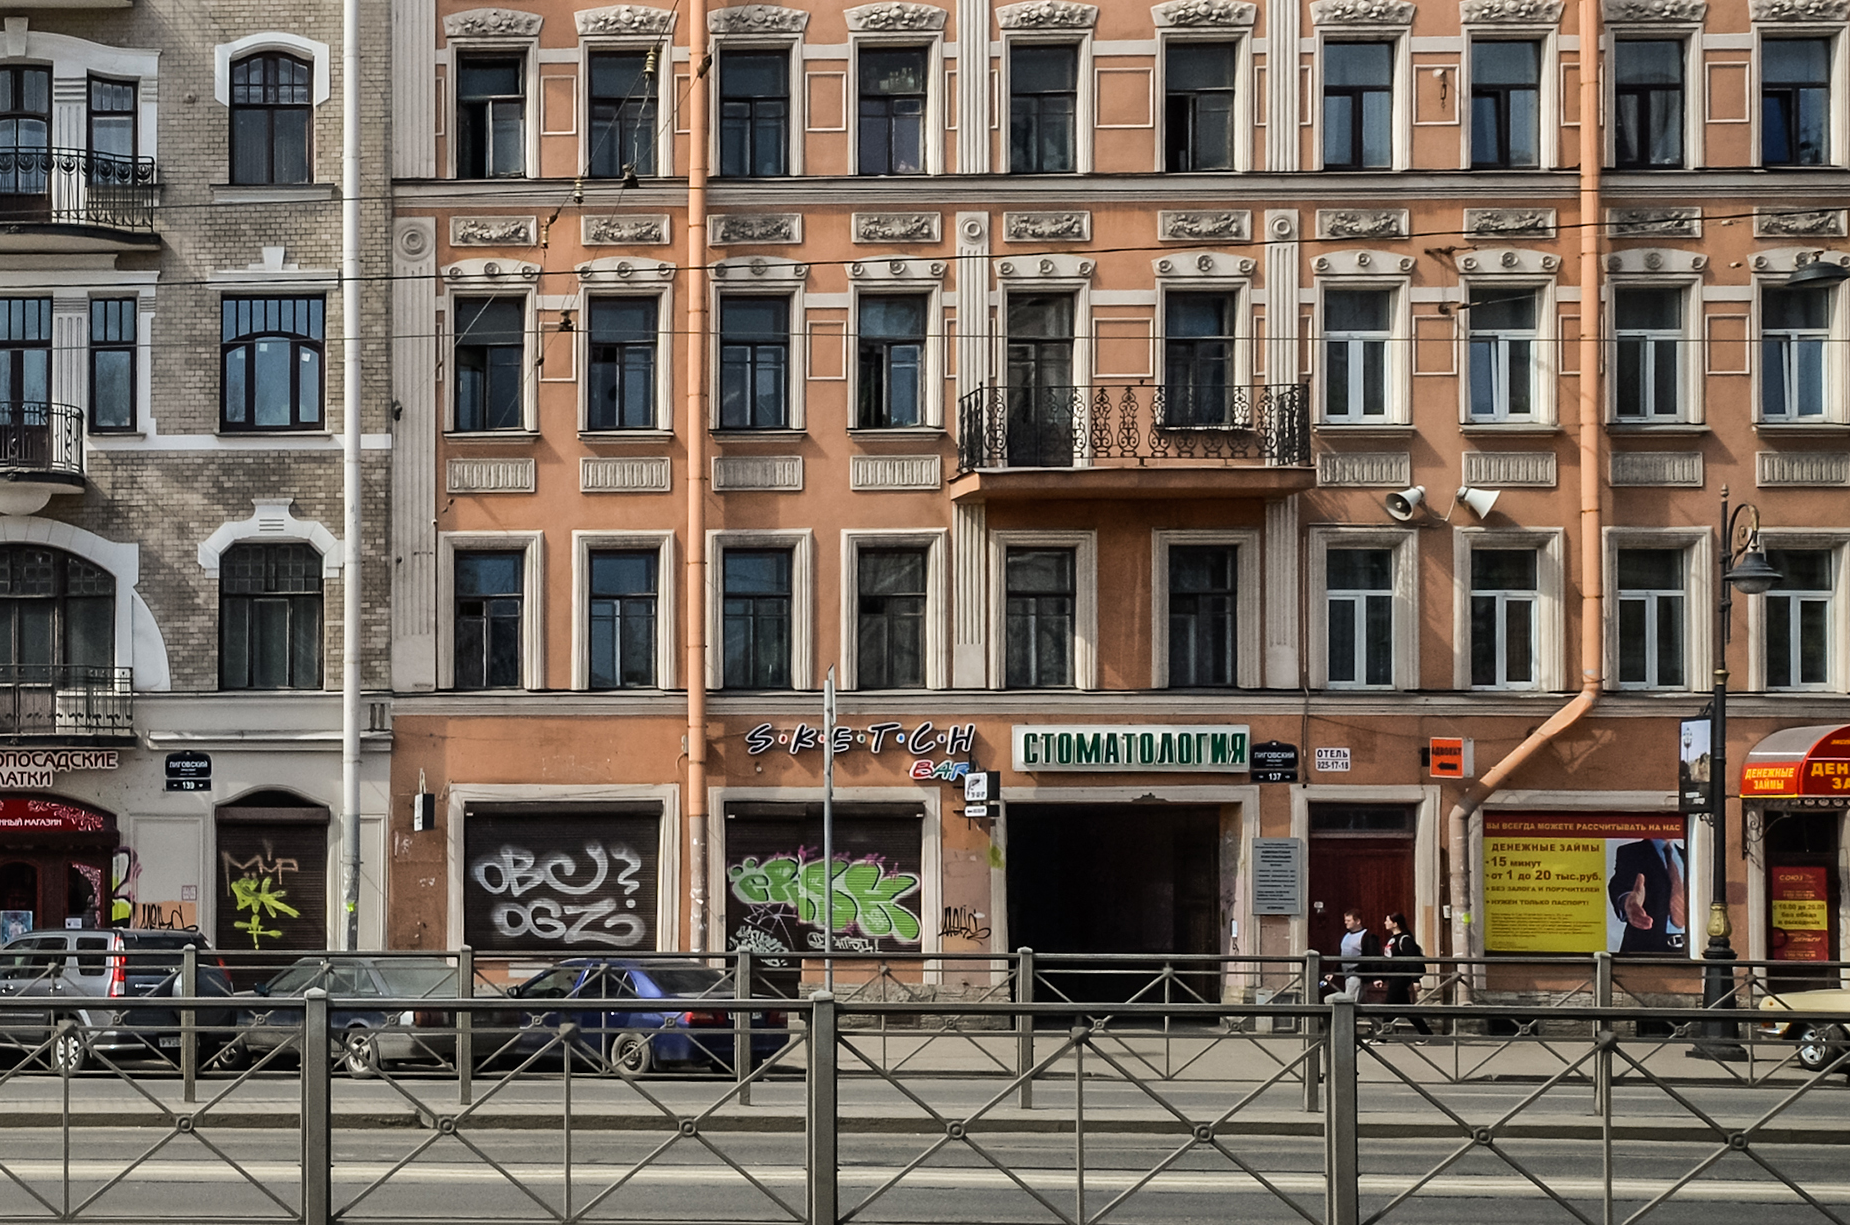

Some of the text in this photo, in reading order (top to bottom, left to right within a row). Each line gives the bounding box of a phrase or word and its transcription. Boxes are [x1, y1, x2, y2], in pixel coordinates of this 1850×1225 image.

[1023, 732, 1247, 765] СТОМАТОЛОГИЯ
[1317, 749, 1348, 758] ОТЕЛЬ
[909, 759, 971, 782] BAR
[1745, 767, 1795, 781] ДЕНЕЖНЫЕ
[1268, 772, 1282, 781] 137
[1753, 779, 1785, 790] ЗАЙМЫ
[25, 818, 62, 827] МАГАЗИН
[1486, 822, 1500, 830] ВЫ
[1502, 822, 1535, 831] ВСЕГДА
[1537, 822, 1574, 831] МОЖЕТЕ
[1576, 823, 1646, 831] РАССЧИТЫВАТЬ
[1491, 841, 1600, 852] ДЕНЕЖНЫЕ ЗАЙМЫ
[1491, 856, 1541, 870] 15 минут
[1491, 870, 1602, 883] от 1 до 20 тыс.руб.
